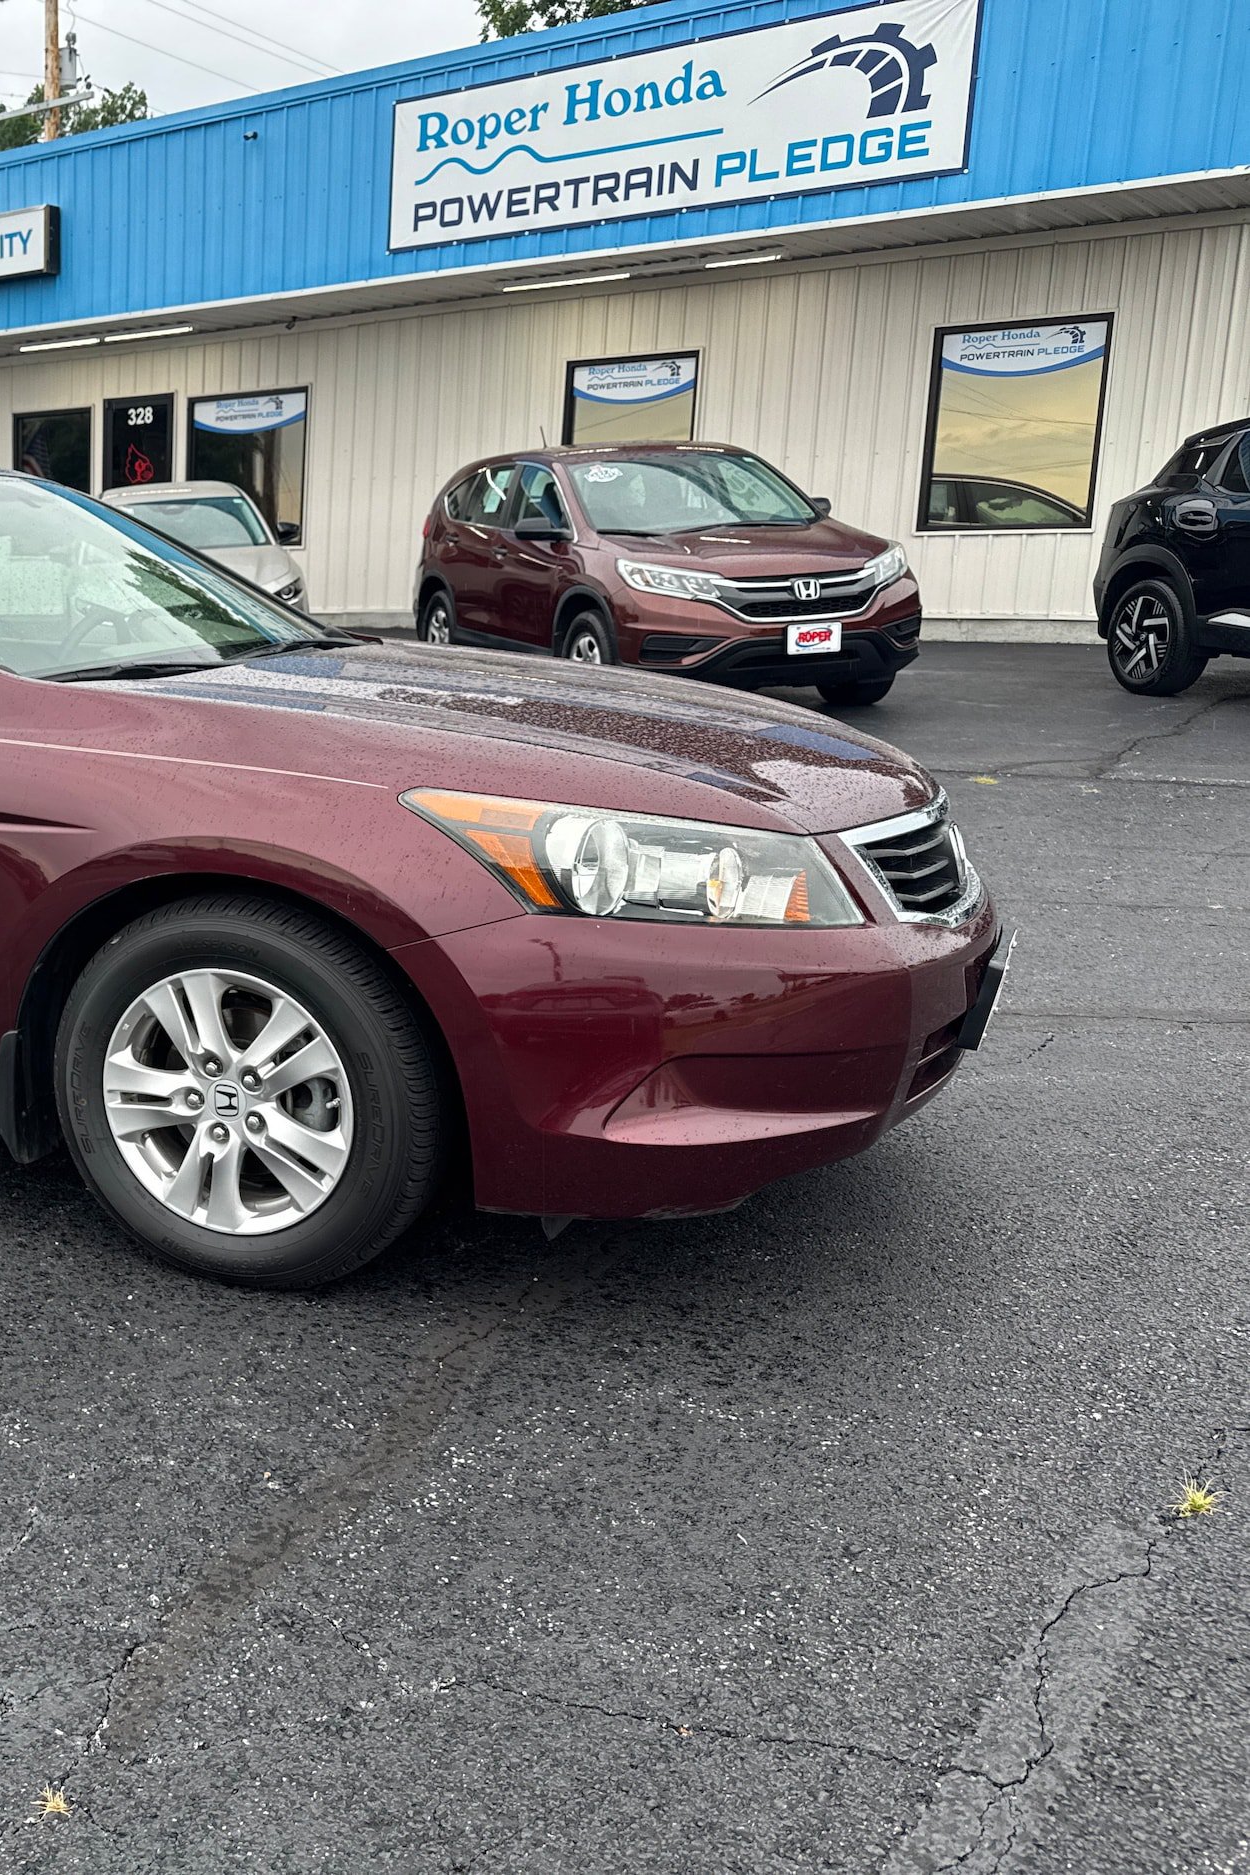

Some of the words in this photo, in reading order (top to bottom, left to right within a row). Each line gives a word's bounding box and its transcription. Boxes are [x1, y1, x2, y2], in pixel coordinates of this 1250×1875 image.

[415, 101, 549, 152] Roper
[563, 59, 727, 127] Honda
[413, 158, 699, 233] POWERTRAIN
[714, 119, 932, 188] PLEDGE
[962, 333, 998, 345] Roper
[1000, 329, 1041, 341] Honda
[959, 349, 1035, 362] POWERTRAIN
[1037, 345, 1085, 356] PLEDGE
[588, 365, 616, 376] Roper
[618, 363, 647, 373] Honda
[586, 380, 644, 391] POWERTRAIN
[645, 377, 680, 387] PLEDGE
[127, 406, 154, 426] 328
[798, 629, 833, 643] ROPER
